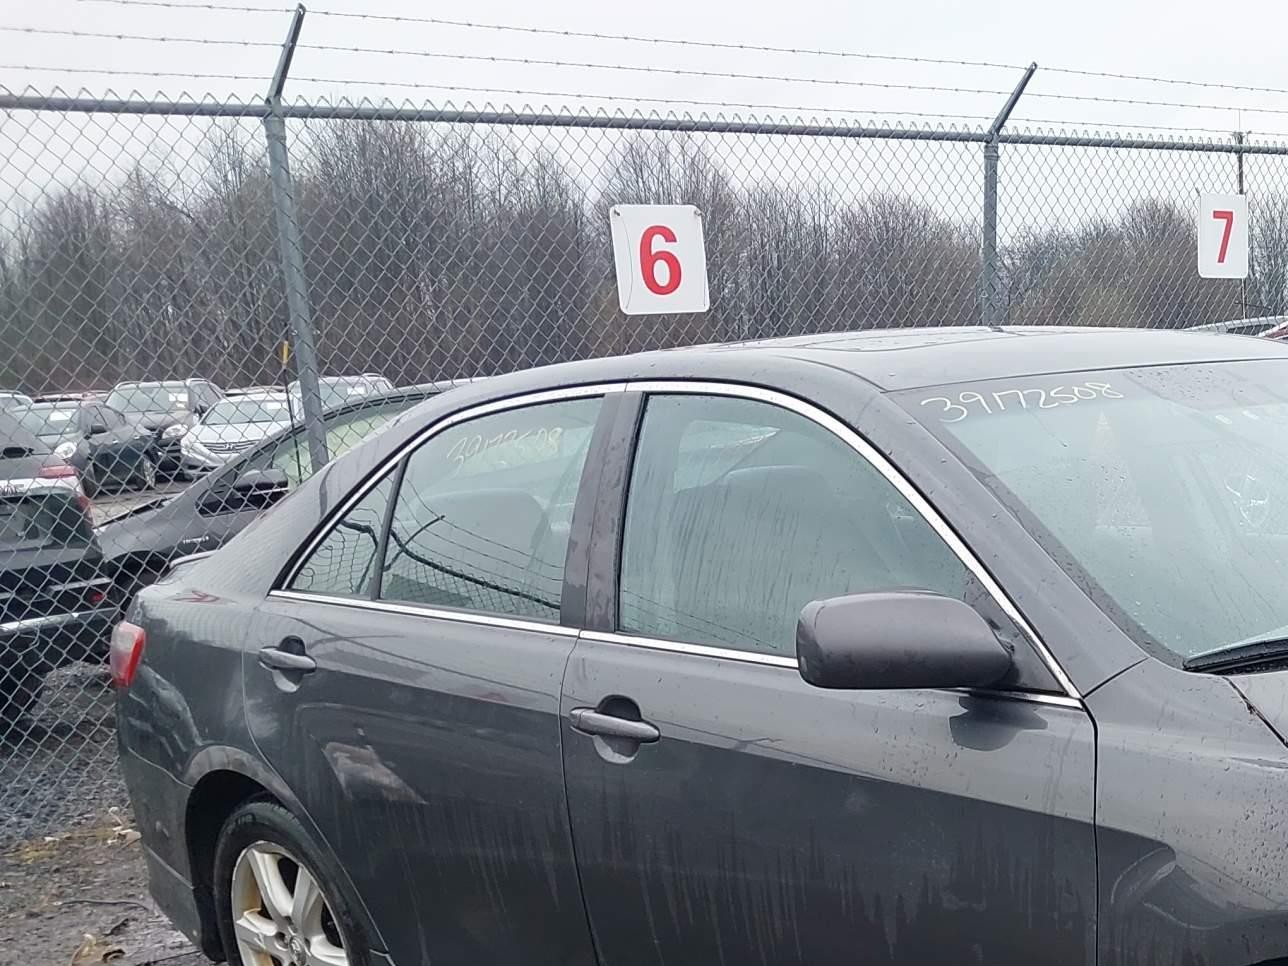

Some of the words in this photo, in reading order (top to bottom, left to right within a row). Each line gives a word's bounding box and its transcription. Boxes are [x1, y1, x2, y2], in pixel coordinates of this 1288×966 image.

[640, 225, 682, 296] 6
[1212, 210, 1234, 264] 7
[920, 381, 1125, 423] 39172508
